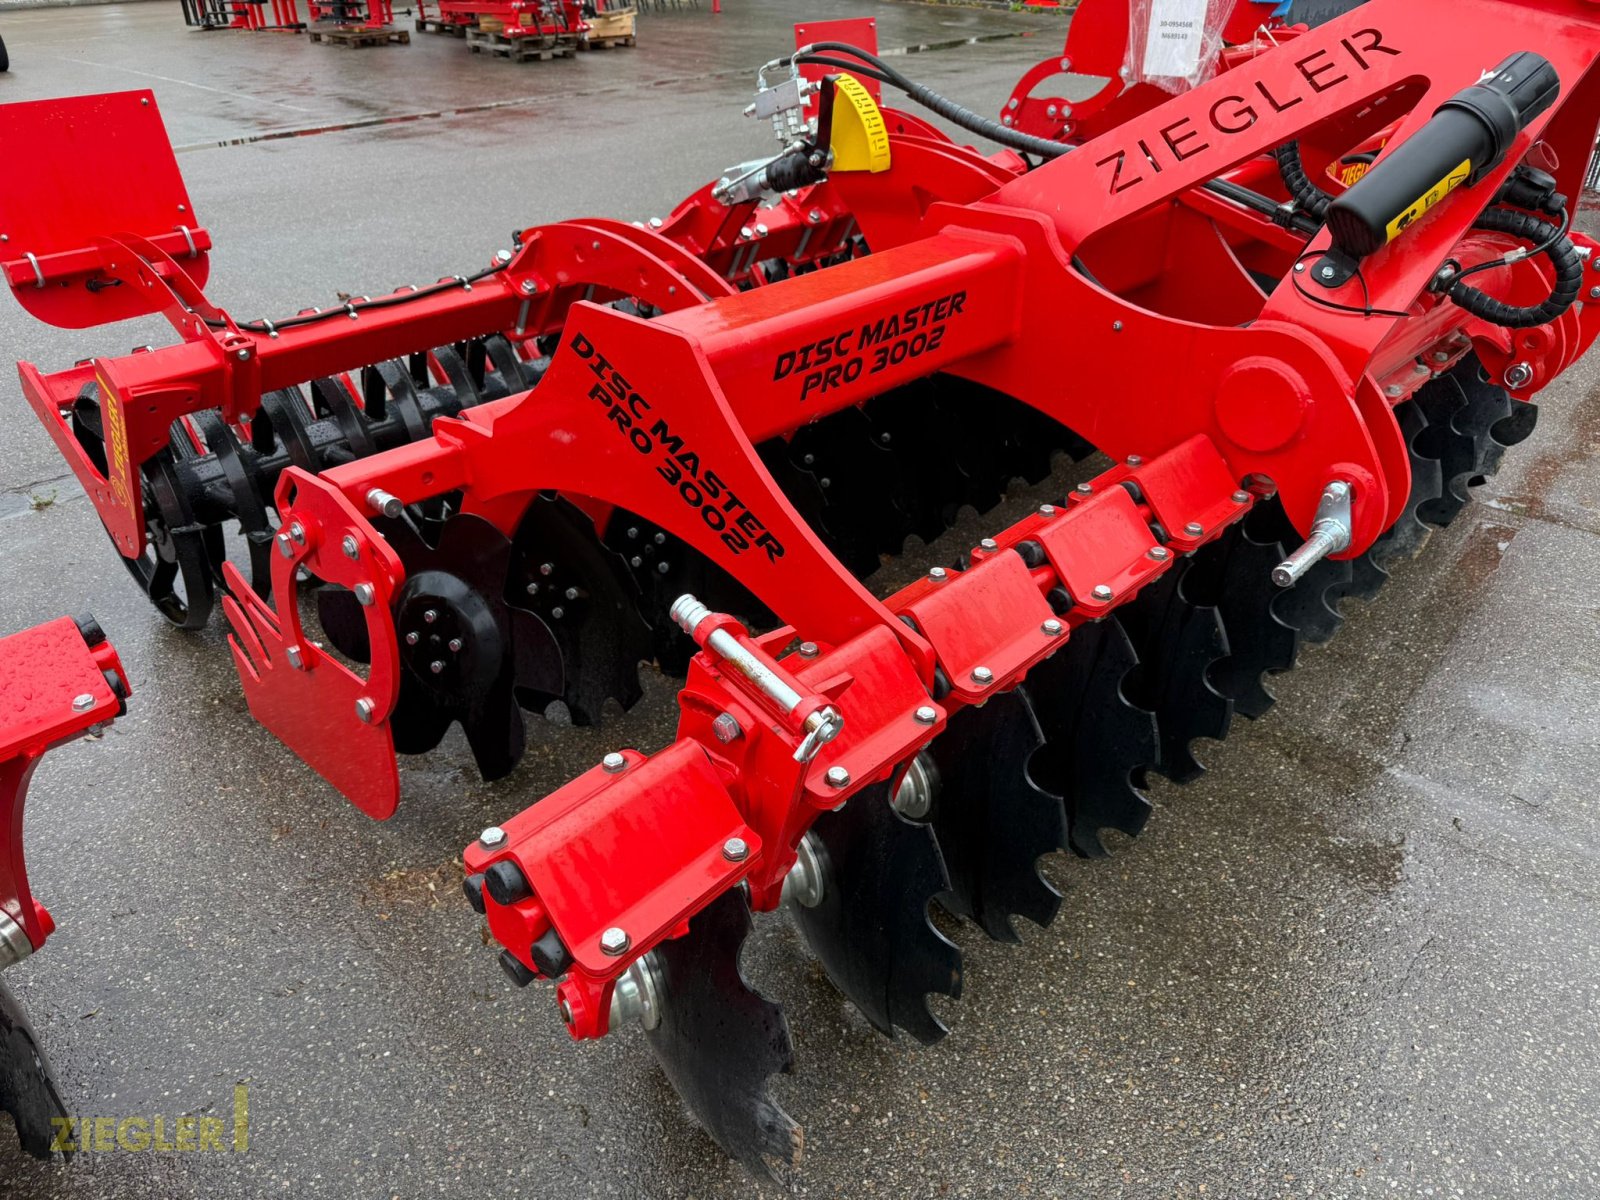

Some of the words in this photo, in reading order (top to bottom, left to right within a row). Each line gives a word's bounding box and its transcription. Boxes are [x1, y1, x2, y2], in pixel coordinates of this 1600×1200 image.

[854, 99, 863, 109] 3
[865, 118, 873, 129] 2
[1095, 28, 1402, 195] ZIEGLER
[773, 329, 853, 381] DISC
[858, 290, 966, 350] MASTER
[801, 357, 863, 401] PRO
[869, 324, 946, 375] 3002
[569, 332, 651, 419] DISC
[650, 418, 786, 565] MASTER
[587, 382, 653, 455] PRO
[656, 458, 751, 555] 3002
